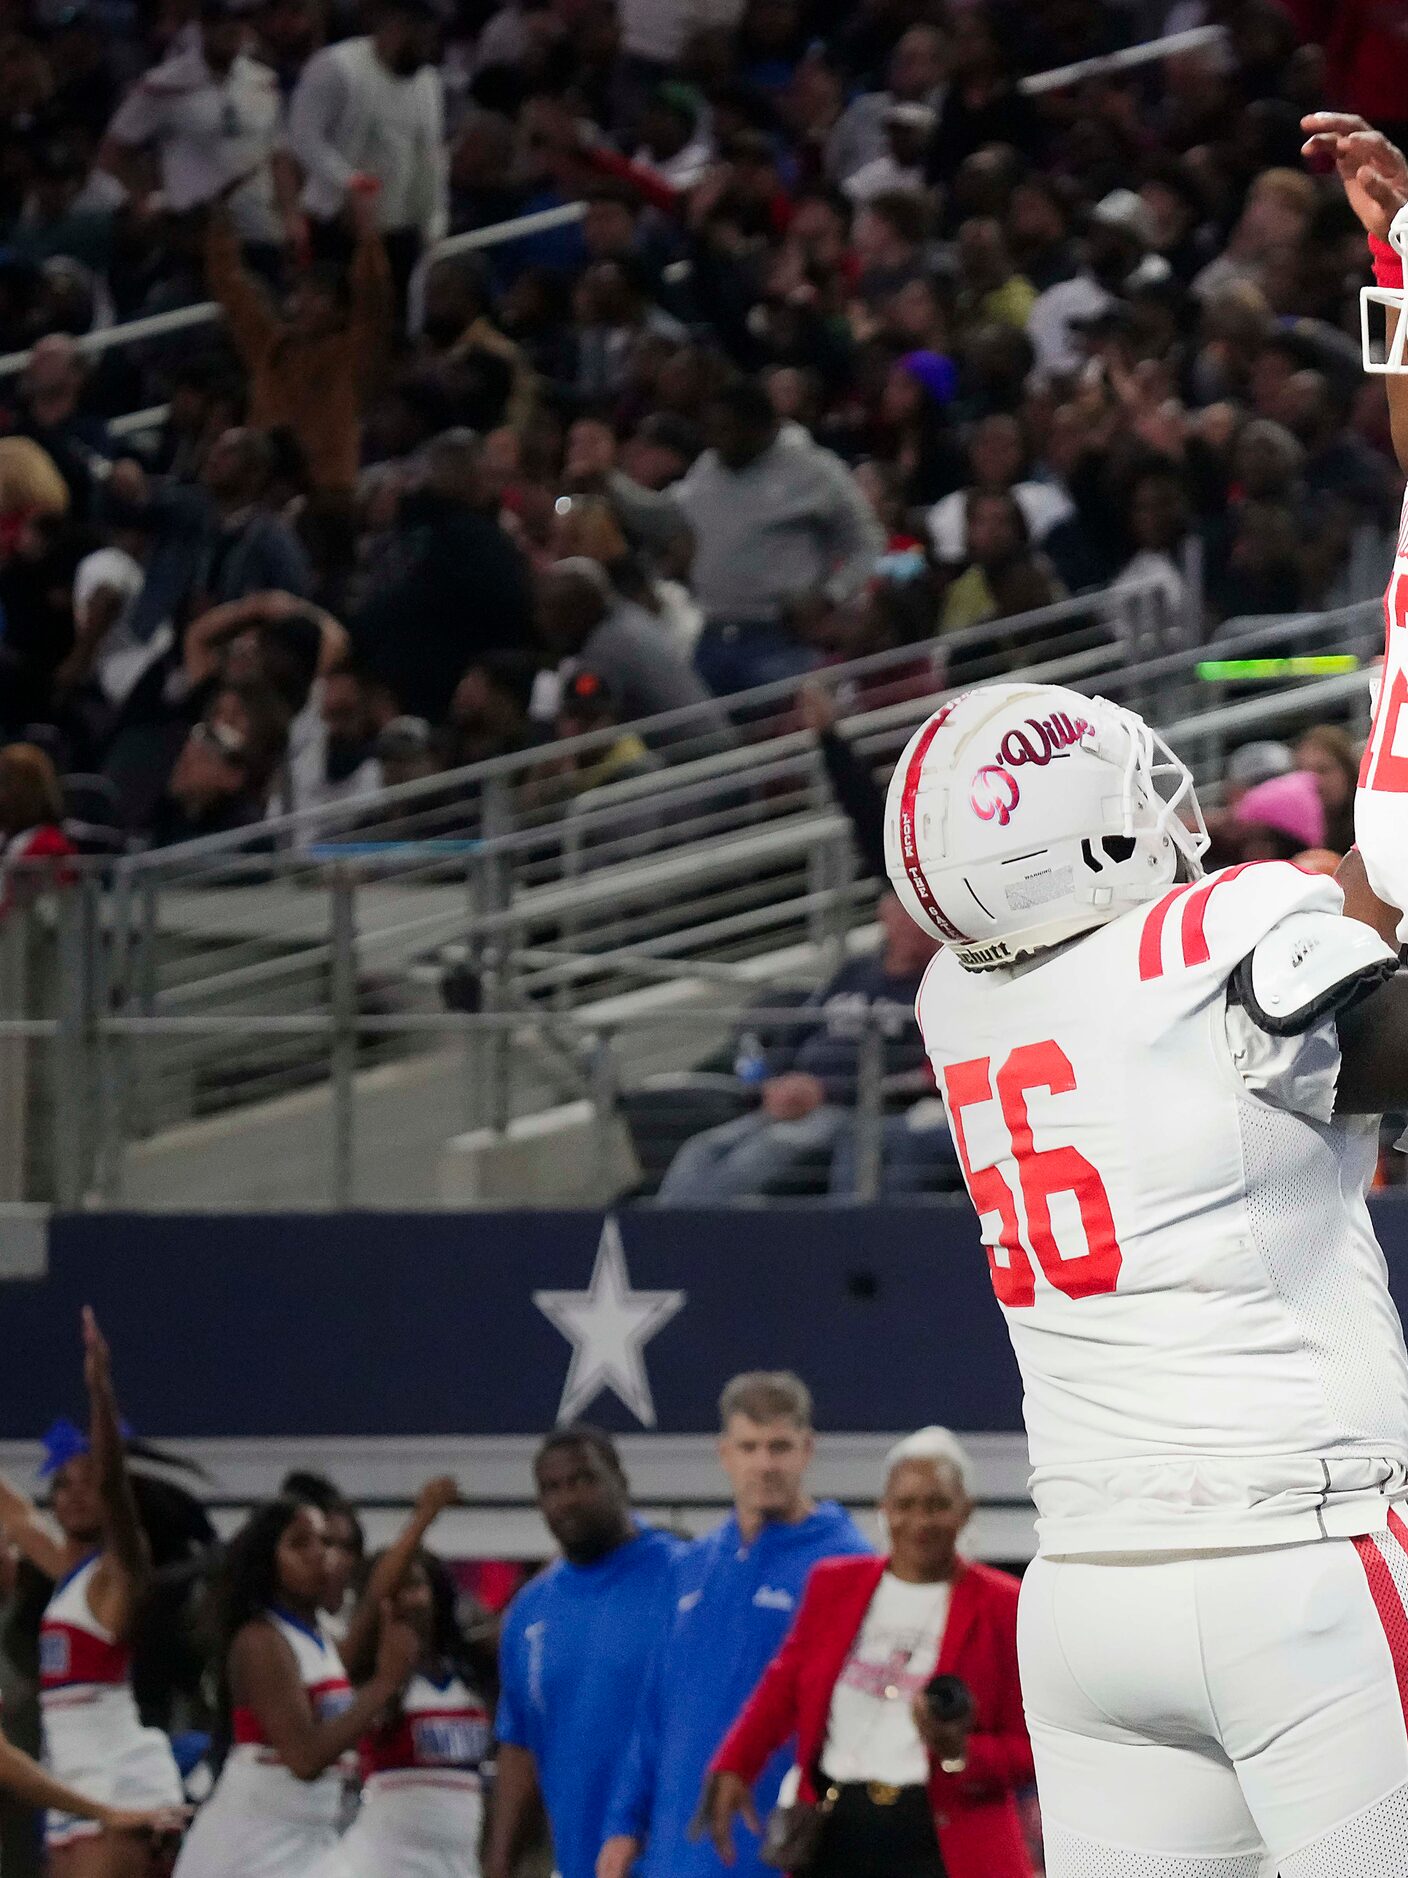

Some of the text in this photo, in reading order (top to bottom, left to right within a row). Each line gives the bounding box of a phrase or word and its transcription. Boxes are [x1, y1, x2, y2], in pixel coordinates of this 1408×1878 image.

[902, 811, 915, 858] LOCK
[908, 866, 929, 899] THE
[943, 1038, 1124, 1308] 56
